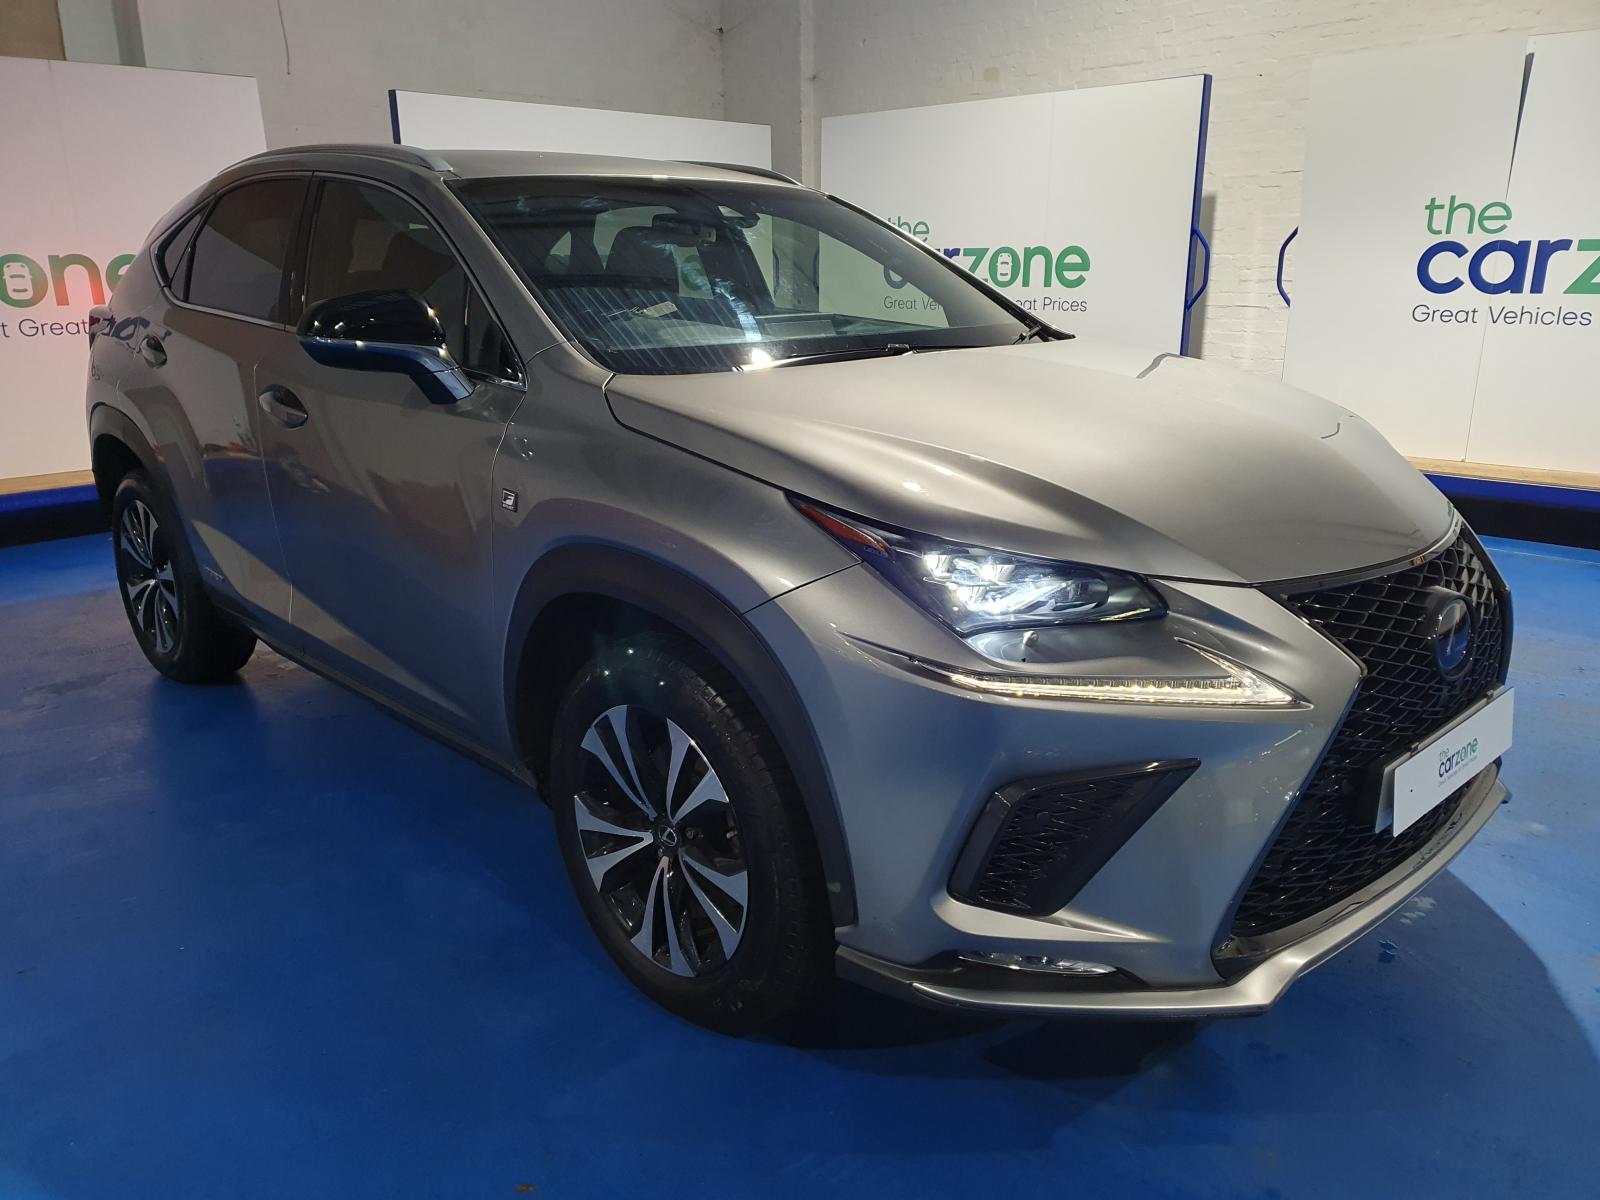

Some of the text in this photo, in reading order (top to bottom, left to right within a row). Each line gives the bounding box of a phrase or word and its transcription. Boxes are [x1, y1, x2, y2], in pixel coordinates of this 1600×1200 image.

[1425, 195, 1513, 235] the
[888, 216, 930, 242] he
[1416, 239, 1600, 295] carz
[884, 296, 917, 310] Great
[1043, 297, 1088, 312] Prices
[1412, 304, 1592, 326] Great Vehicles
[19, 318, 89, 337] Great
[1439, 737, 1478, 778] carzone
